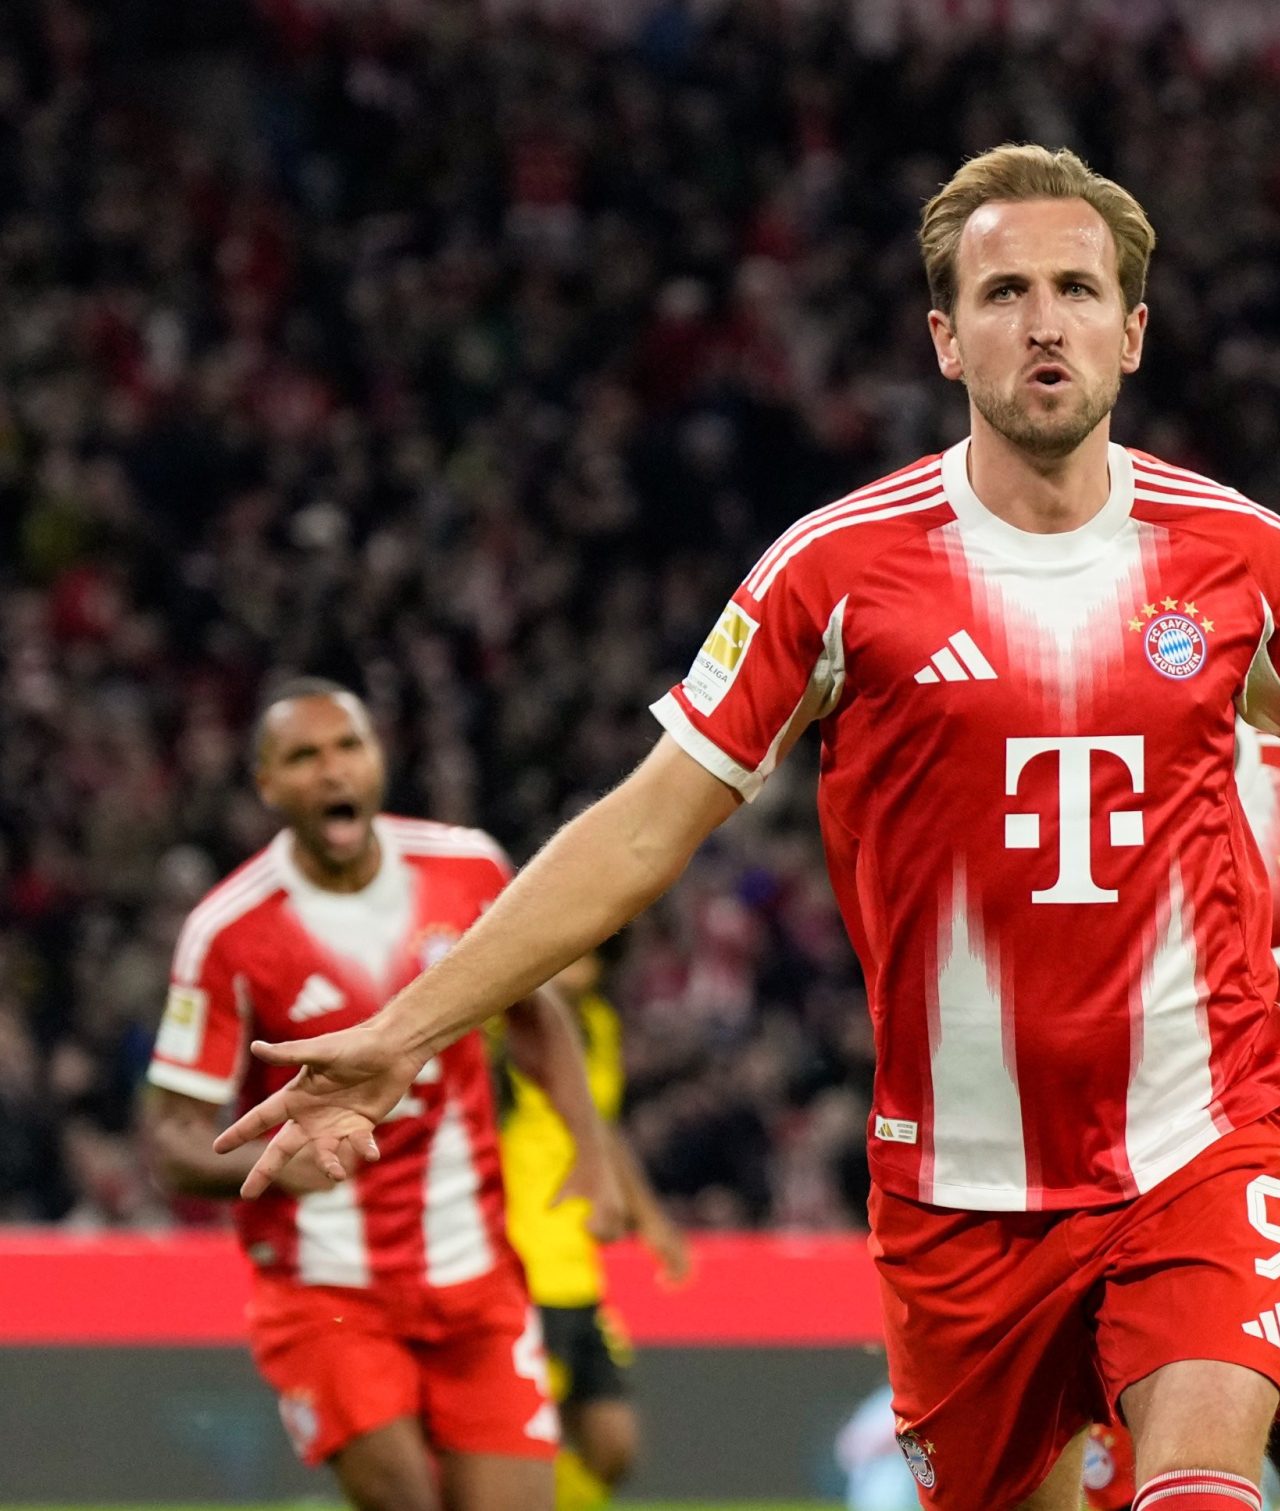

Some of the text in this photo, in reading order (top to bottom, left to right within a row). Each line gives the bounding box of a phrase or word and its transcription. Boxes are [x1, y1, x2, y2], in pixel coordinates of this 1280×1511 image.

[1149, 619, 1200, 643] FC BAYERN
[1005, 735, 1145, 904] T
